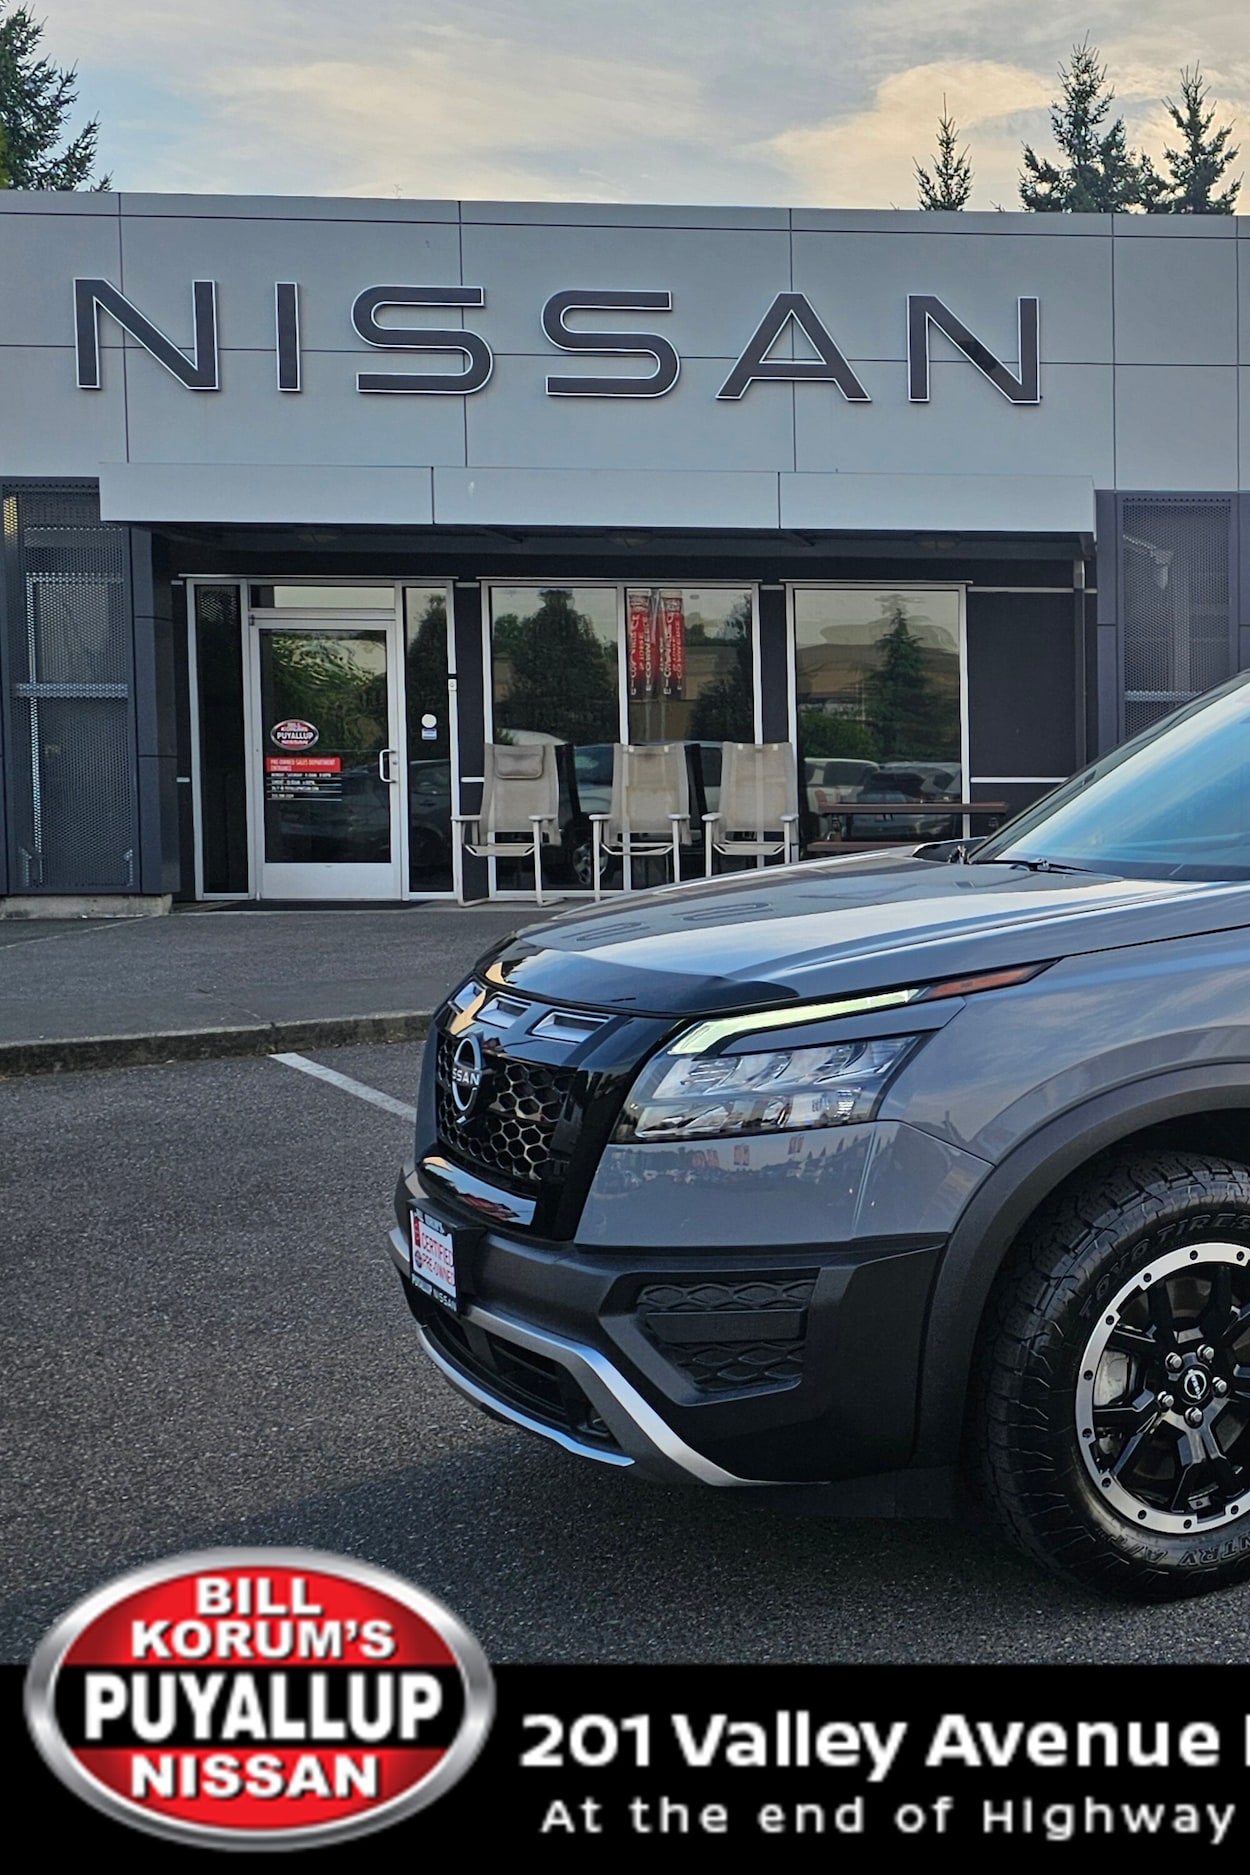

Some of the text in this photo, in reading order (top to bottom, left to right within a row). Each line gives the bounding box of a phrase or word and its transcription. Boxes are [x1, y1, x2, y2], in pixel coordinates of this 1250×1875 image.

[74, 278, 1041, 405] NISSAN
[276, 731, 314, 740] PUYALLUP
[421, 1231, 454, 1267] CERTIFIED
